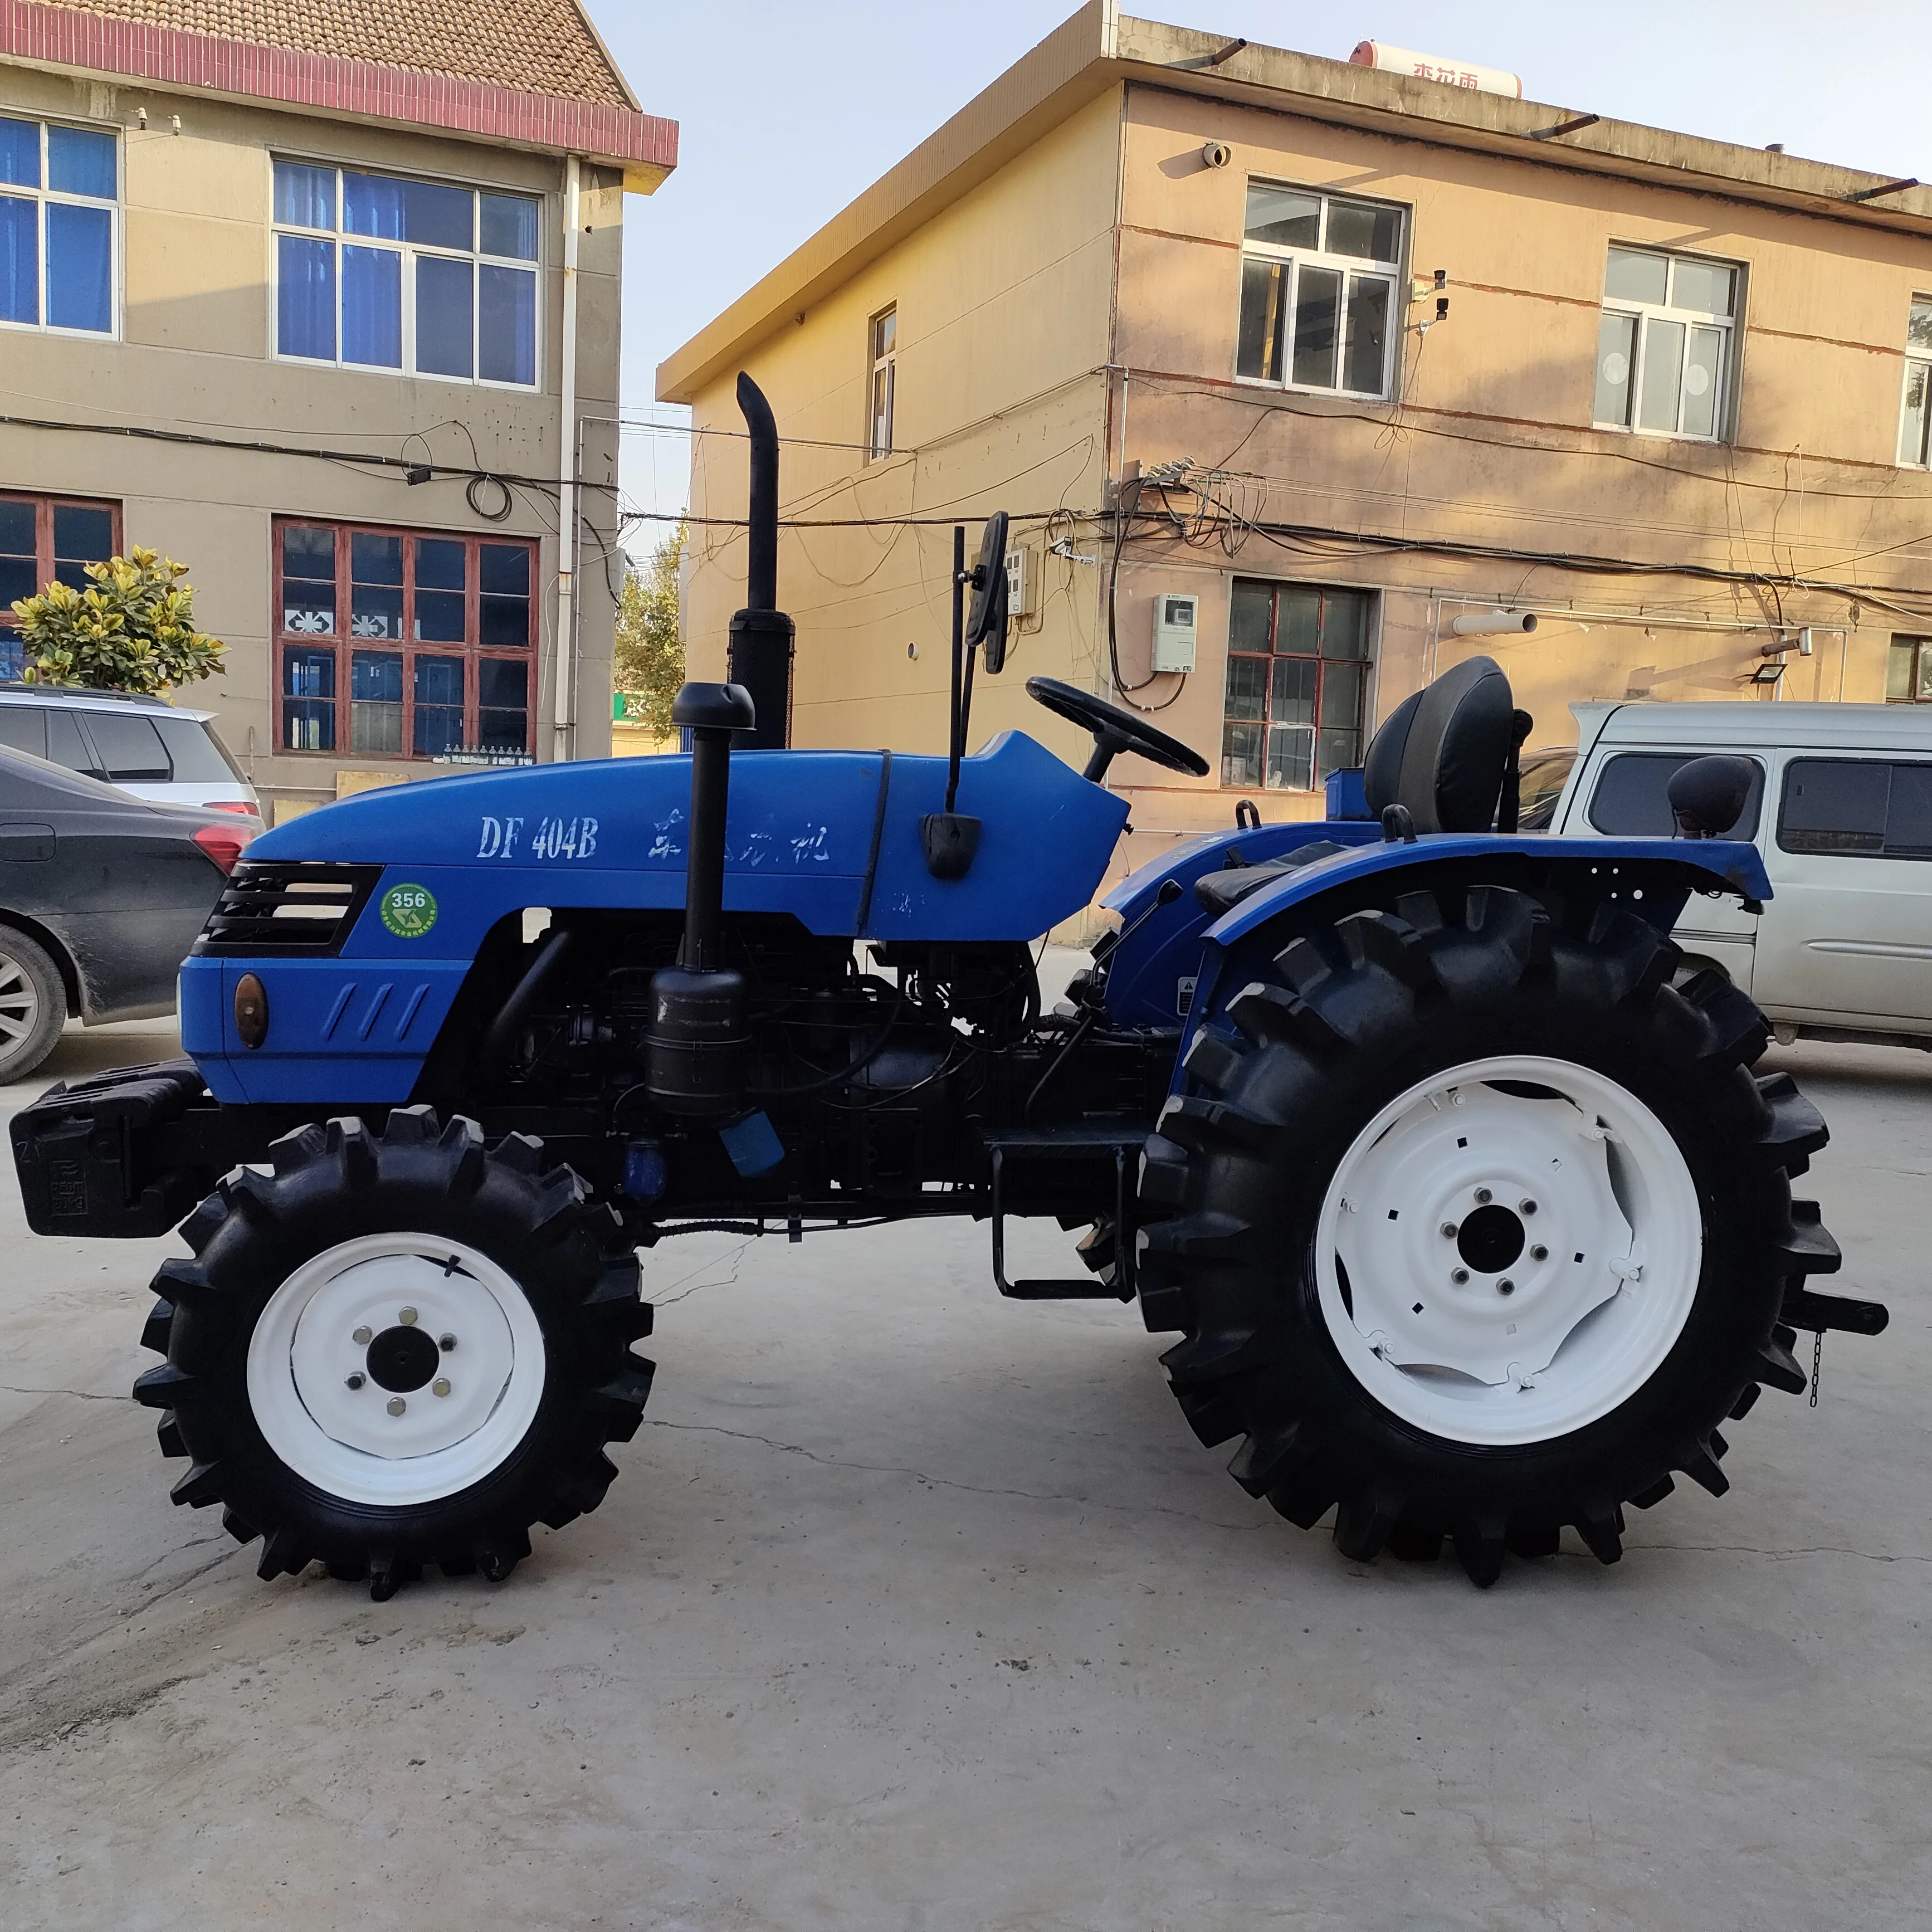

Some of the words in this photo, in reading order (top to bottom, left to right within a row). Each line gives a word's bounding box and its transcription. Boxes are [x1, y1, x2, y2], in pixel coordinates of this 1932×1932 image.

[476, 817, 524, 858] DF
[531, 816, 599, 859] 404B
[392, 892, 426, 908] 356
